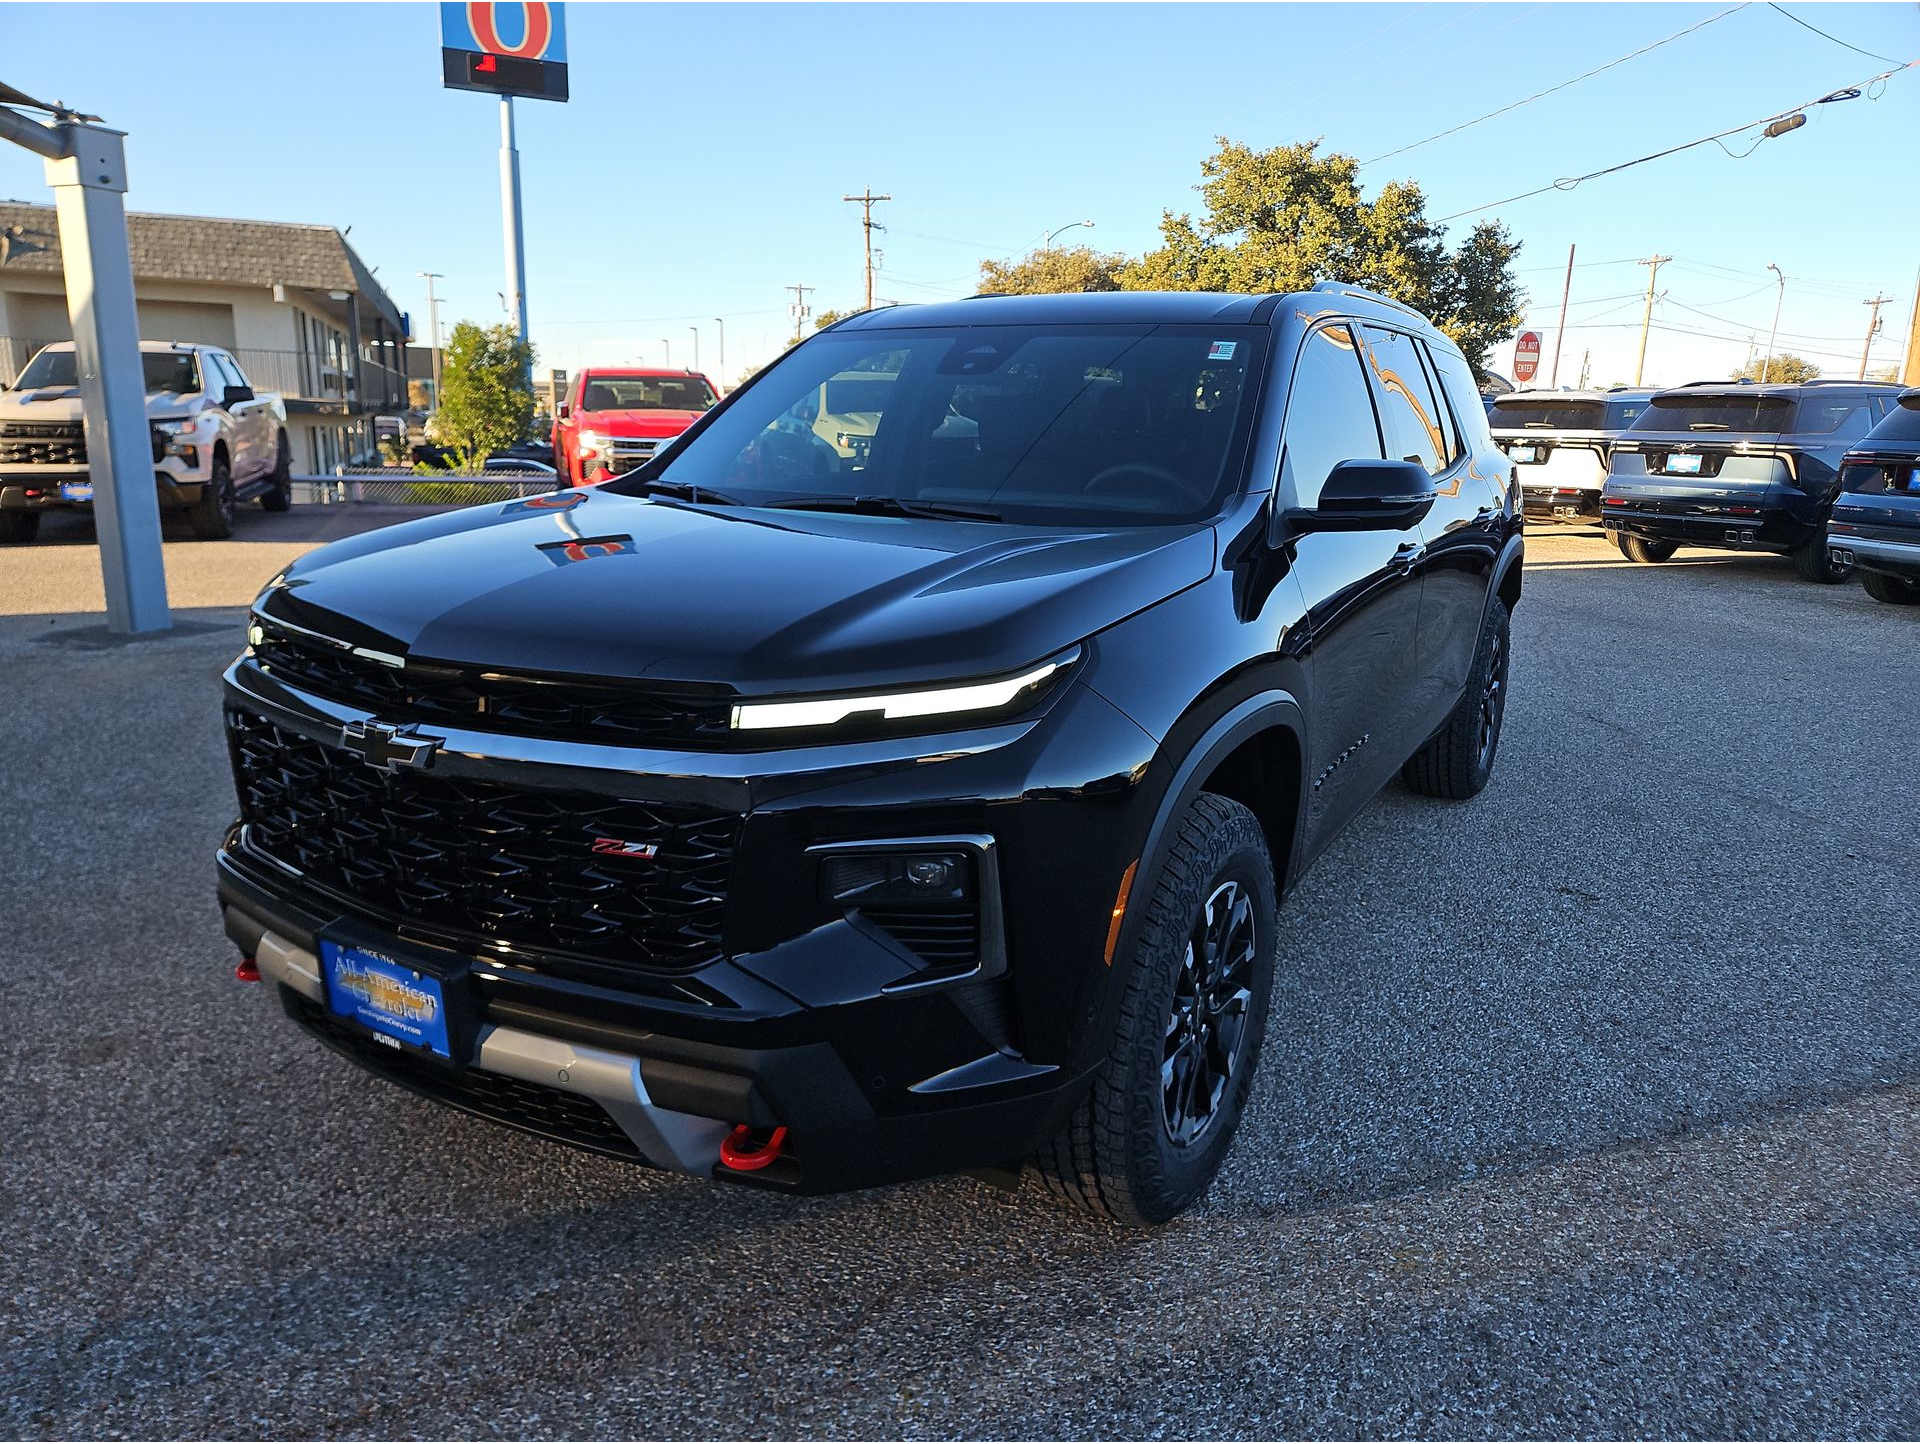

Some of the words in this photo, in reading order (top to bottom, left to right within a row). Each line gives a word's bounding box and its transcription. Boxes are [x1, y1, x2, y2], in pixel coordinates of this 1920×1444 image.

[1519, 341, 1527, 350] DO
[1528, 341, 1538, 350] NOT
[1517, 364, 1534, 374] ENTER
[591, 838, 658, 859] Z71
